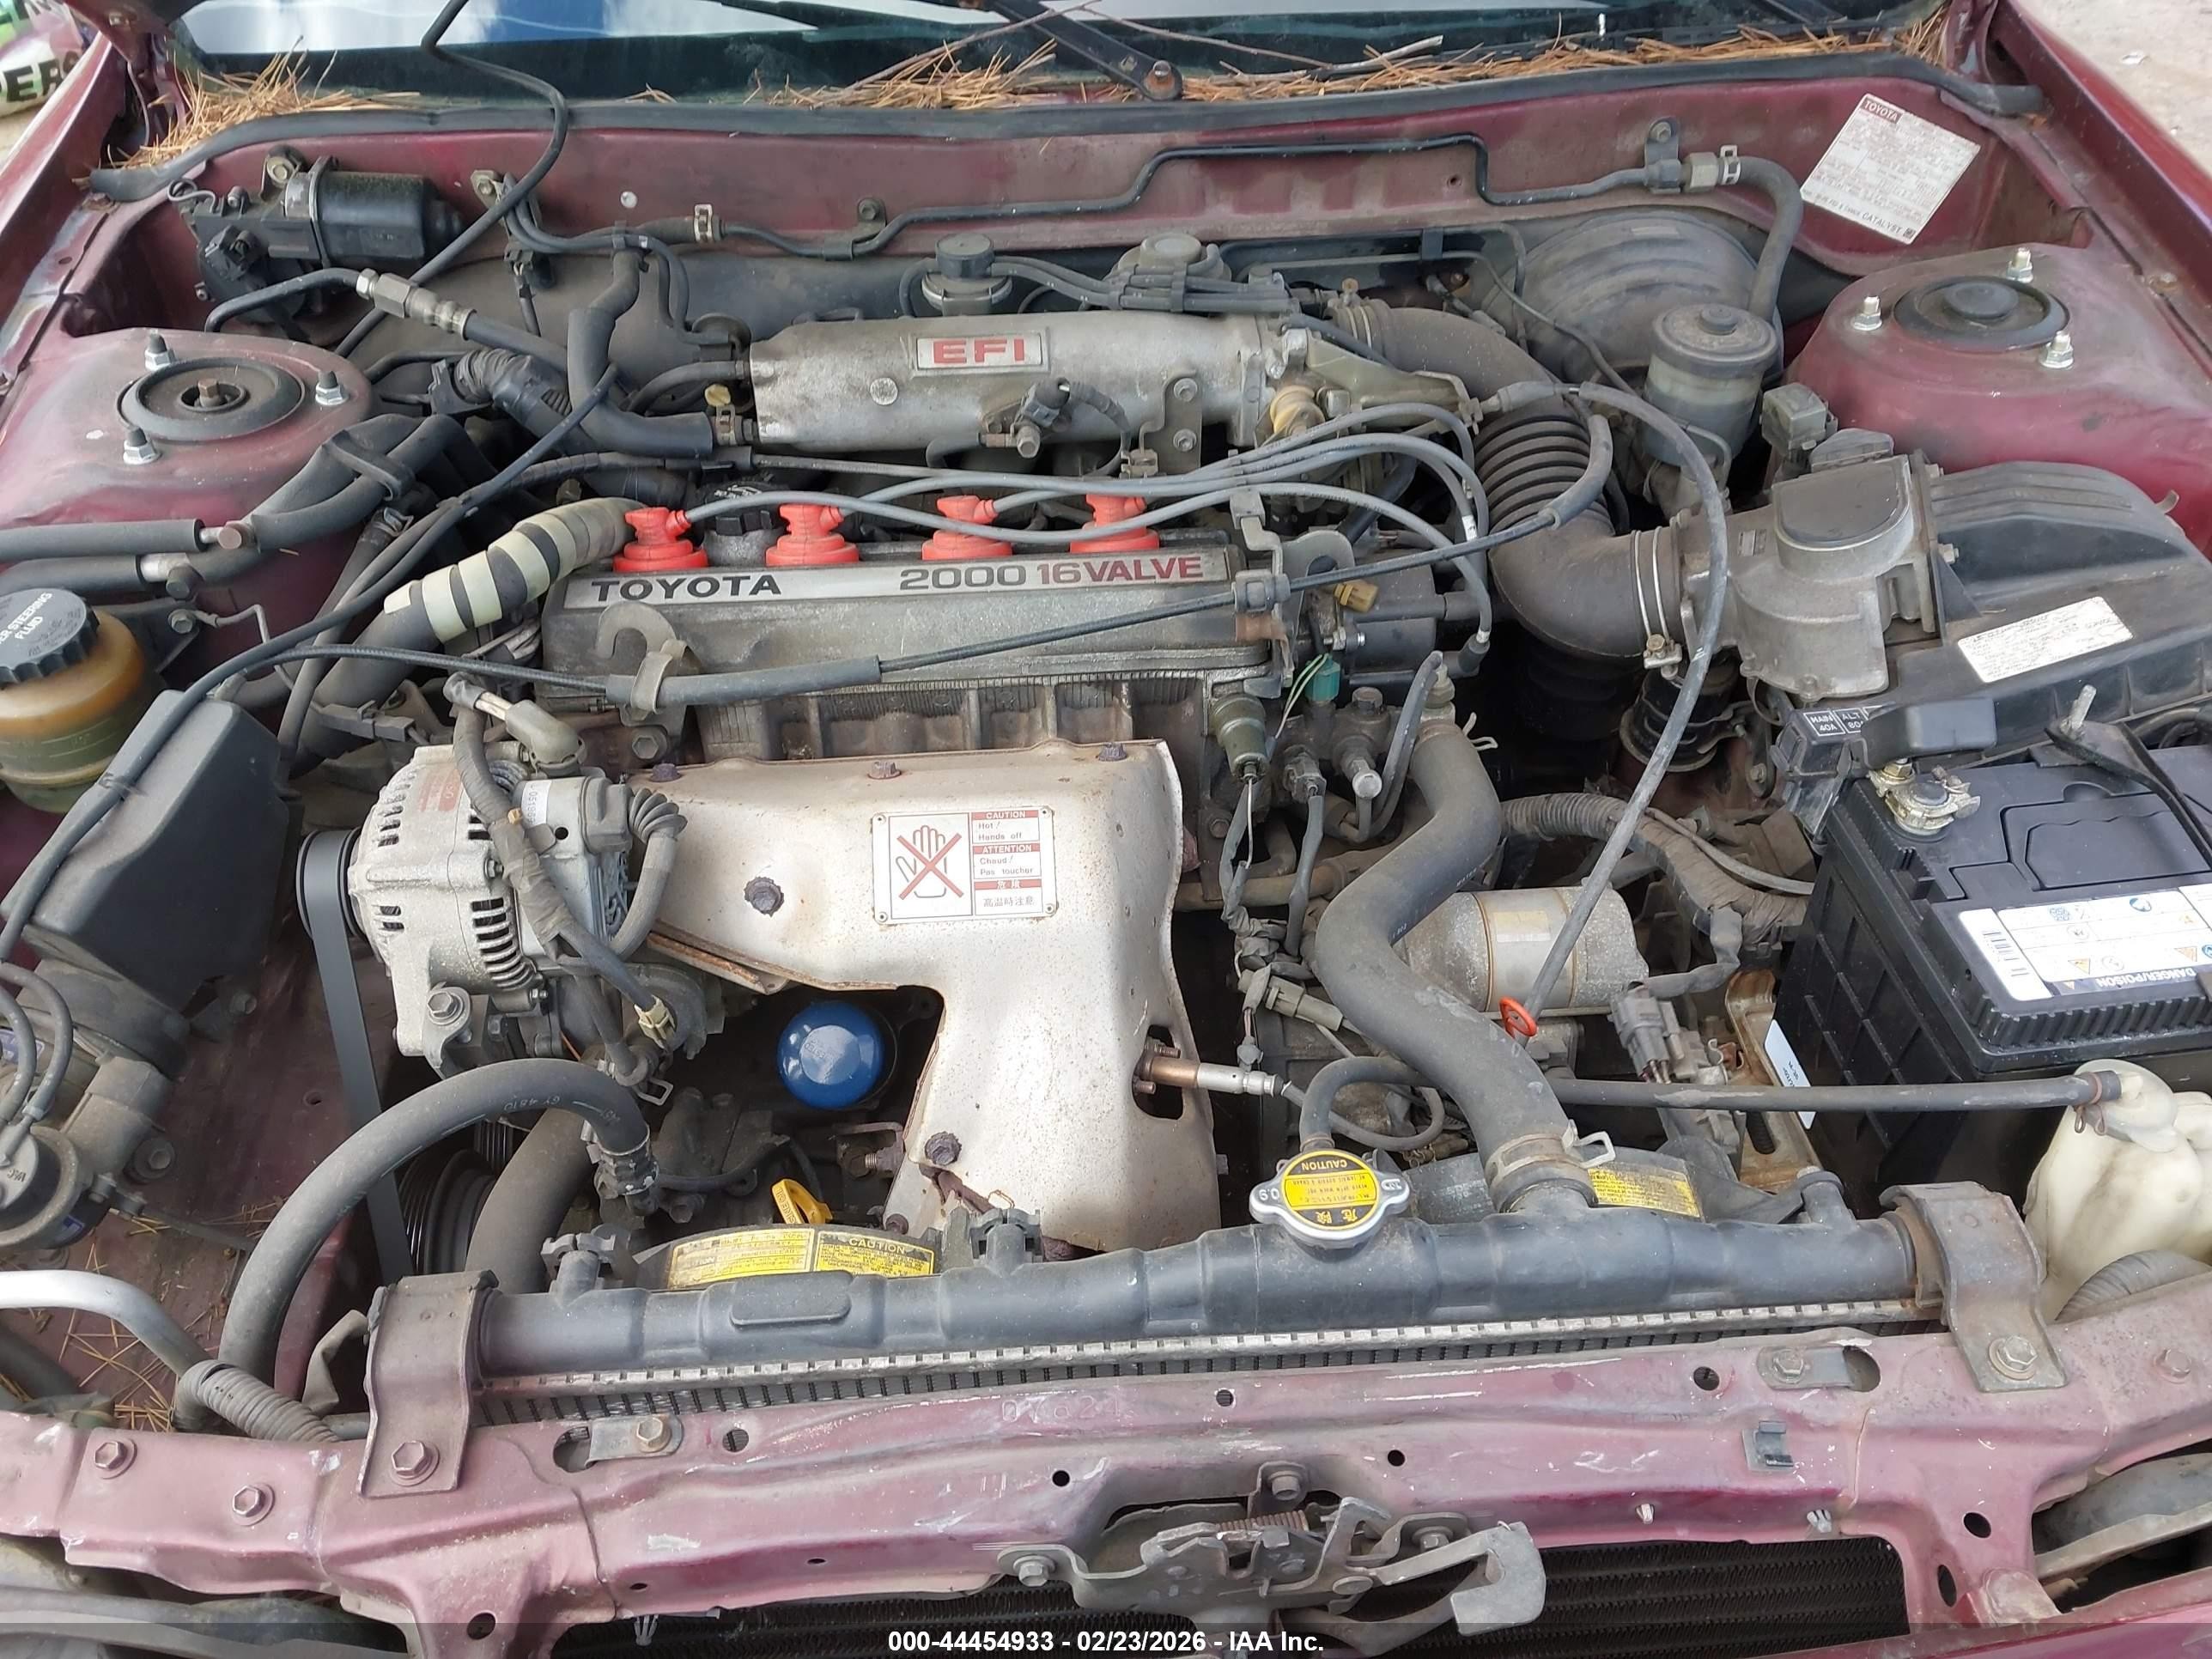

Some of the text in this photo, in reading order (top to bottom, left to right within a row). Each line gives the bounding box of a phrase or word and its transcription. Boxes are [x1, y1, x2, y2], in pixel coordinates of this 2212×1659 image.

[1863, 100, 1899, 123] TOYOTA
[1862, 212, 1902, 234] CATALYST
[933, 337, 1025, 364] EFI
[591, 574, 782, 603] TOYOTA
[899, 563, 1027, 592] 2000
[8, 592, 53, 630] STEERING
[14, 616, 44, 640] FLUID
[1810, 712, 1862, 723] MAIN ALT
[1820, 720, 1863, 732] 40A 80
[986, 811, 1026, 819] CAUTION
[978, 833, 1006, 842] Hands
[982, 844, 1032, 854] ATTENTION
[1002, 866, 1034, 875] toucher
[2096, 966, 2197, 988] DANGER/POISON
[1301, 1159, 1348, 1171] CAUTION
[1315, 1209, 1358, 1224] 危険
[849, 1237, 908, 1254] CAUTION
